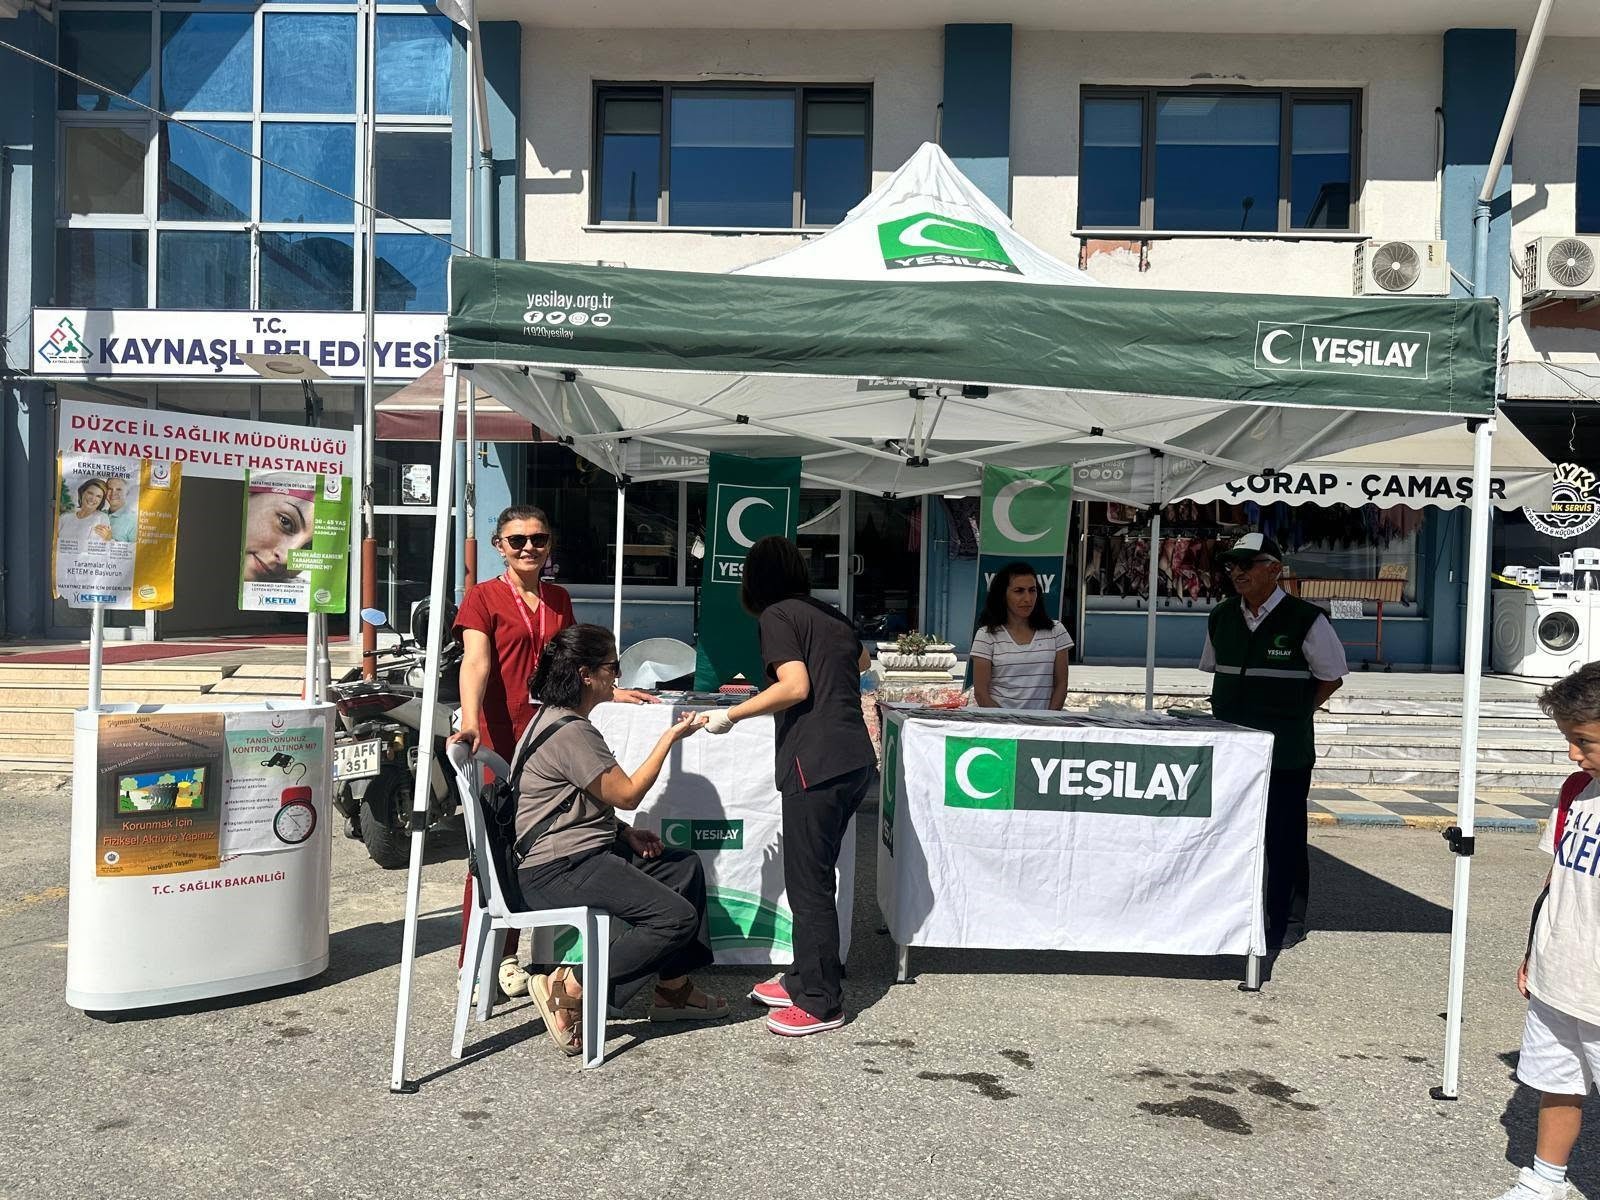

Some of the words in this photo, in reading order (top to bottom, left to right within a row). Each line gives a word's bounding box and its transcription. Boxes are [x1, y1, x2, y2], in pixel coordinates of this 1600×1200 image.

[526, 290, 614, 311] yesilay.org.tr
[252, 317, 287, 334] T.C.
[523, 326, 574, 340] /1920yesilay
[72, 415, 137, 435] DÜZCE
[143, 420, 159, 437] İL
[164, 425, 230, 444] SAĞLIK
[234, 432, 347, 456] MÜDÜRLÜĞÜ
[78, 462, 101, 471] ERKEN
[175, 448, 244, 467] DEVLET
[248, 456, 343, 475] HASTANESİ
[73, 468, 95, 477] HAYAT
[96, 470, 131, 479] KURTARIR
[1564, 504, 1592, 512] SERVİS
[80, 594, 117, 603] KETEM
[265, 597, 296, 605] KETEM
[232, 746, 270, 754] KONTROL
[354, 742, 376, 759] AFK
[346, 758, 368, 772] 351
[122, 821, 172, 831] Korunmak
[175, 816, 193, 828] İçin
[103, 835, 140, 847] Fiziksel
[141, 833, 178, 845] Aktivite
[152, 885, 174, 895] T.C.
[179, 880, 222, 893] SAĞLIK
[224, 870, 285, 888] BAKANLIĞI
